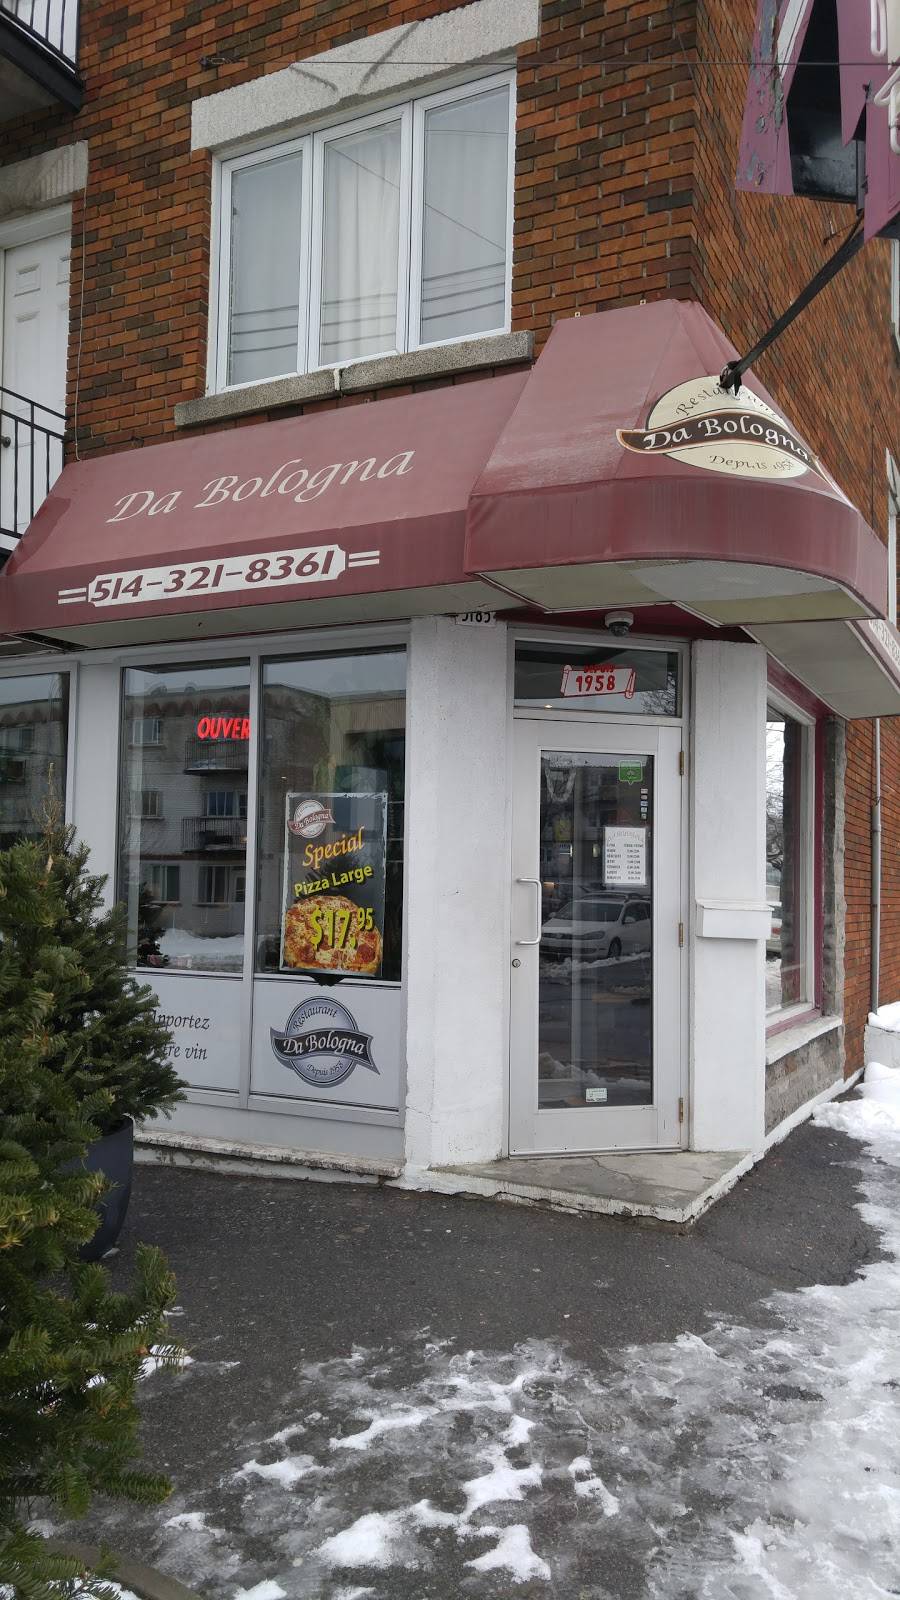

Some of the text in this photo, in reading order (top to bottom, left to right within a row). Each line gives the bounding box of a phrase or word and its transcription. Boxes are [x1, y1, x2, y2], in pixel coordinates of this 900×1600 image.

[644, 415, 811, 462] Da Bologna
[708, 454, 768, 470] Depuis
[106, 450, 416, 523] Da Bologna
[90, 549, 335, 602] 514-321-8361
[576, 675, 616, 692] 1958
[197, 716, 250, 739] OUVER
[302, 826, 365, 870] Special
[294, 865, 373, 897] Pizza Large
[293, 1006, 338, 1031] Restaurant
[184, 1043, 208, 1060] vin
[283, 1031, 365, 1055] Da Bologna
[306, 1064, 328, 1077] Depuis
